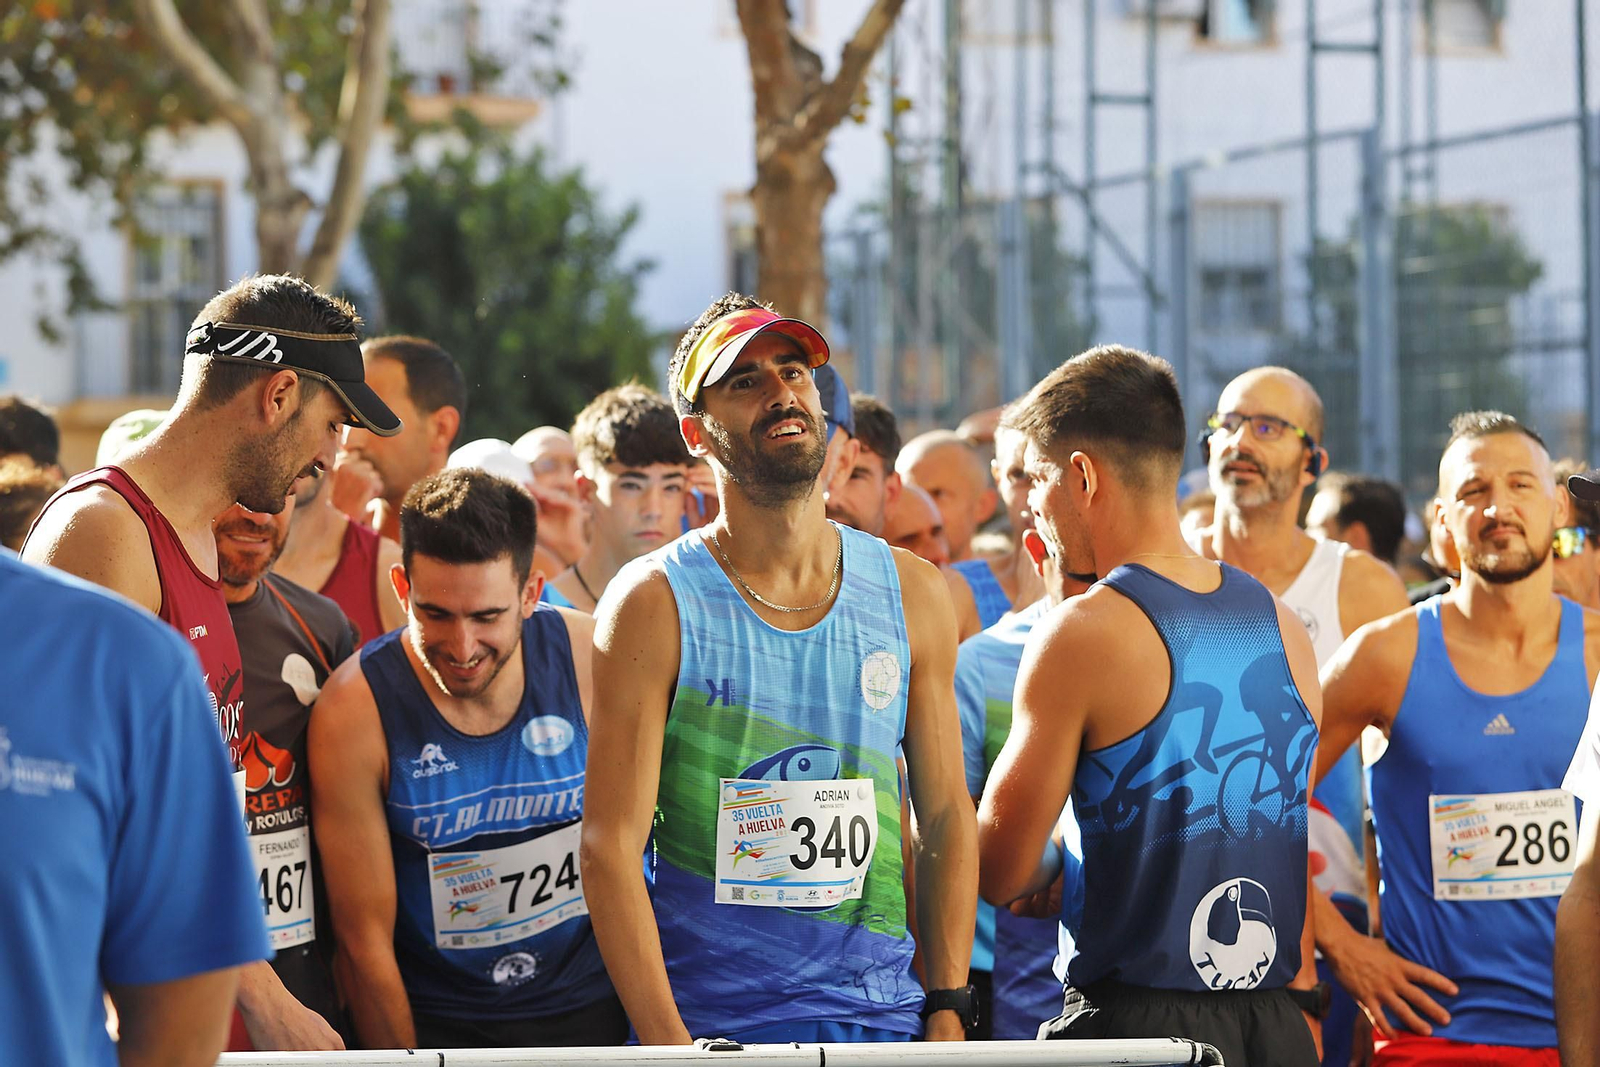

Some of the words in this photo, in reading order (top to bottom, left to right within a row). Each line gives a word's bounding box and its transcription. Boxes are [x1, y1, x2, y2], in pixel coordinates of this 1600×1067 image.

[412, 762, 460, 779] austral
[814, 790, 849, 802] ADRIAN
[1494, 800, 1531, 813] MIGUEL
[1533, 798, 1566, 809] ANGEL
[255, 806, 304, 830] ROTULOS
[732, 809, 744, 822] 35
[745, 804, 783, 820] VUELTA
[1455, 814, 1488, 831] VUELTA
[738, 823, 746, 836] A
[746, 817, 786, 834] HUELVA
[1450, 833, 1457, 842] A
[1457, 826, 1490, 841] HUELVA
[259, 838, 300, 855] FERNANDO
[790, 815, 871, 871] 340
[1495, 820, 1570, 867] 286
[444, 877, 458, 888] 35
[457, 868, 494, 885] VUELTA
[452, 888, 460, 897] A
[461, 878, 497, 895] HUELVA
[500, 851, 580, 914] 724
[258, 860, 307, 916] 467
[1196, 951, 1270, 991] TUCAN
